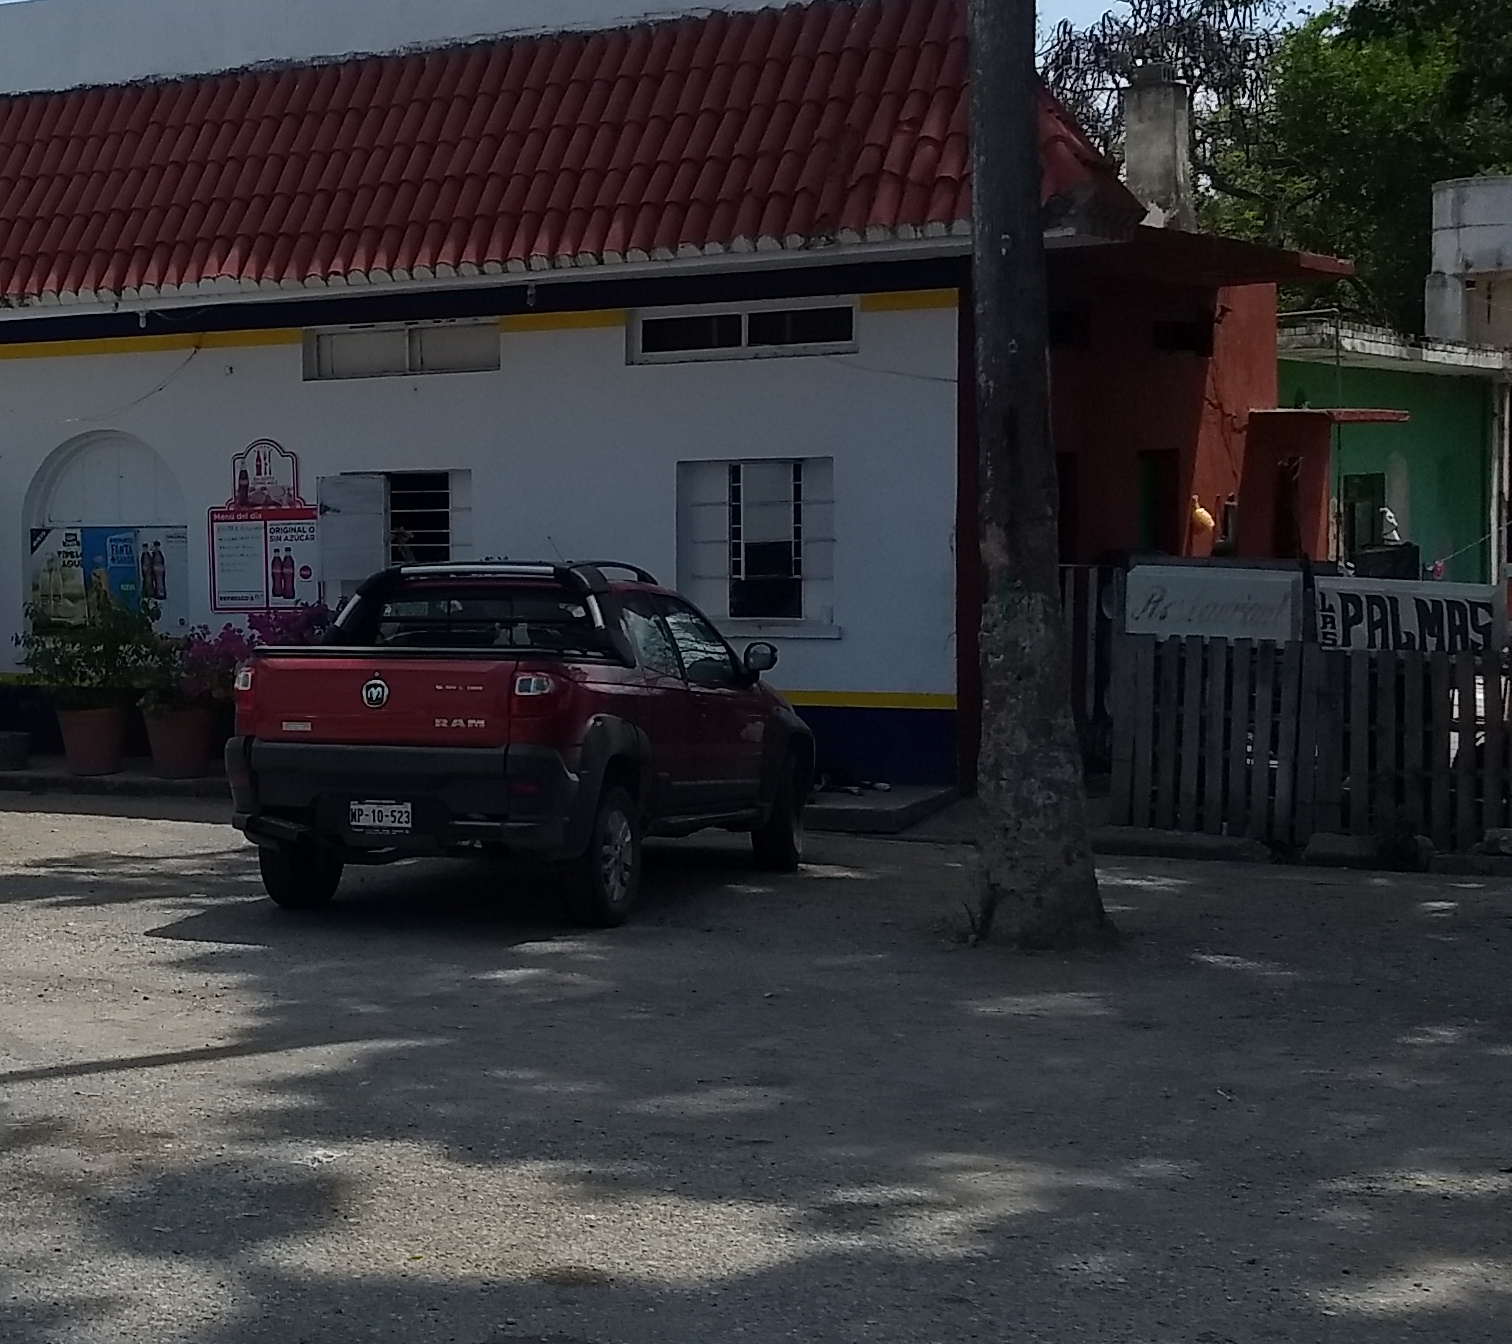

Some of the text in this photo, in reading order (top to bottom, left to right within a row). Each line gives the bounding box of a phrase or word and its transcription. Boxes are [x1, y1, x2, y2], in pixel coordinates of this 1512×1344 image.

[236, 512, 249, 520] del
[269, 526, 307, 534] ORIGINAL
[111, 543, 133, 556] FANTA
[61, 560, 81, 568] AQU
[1339, 592, 1494, 655] PALMAS
[434, 718, 486, 728] RAM
